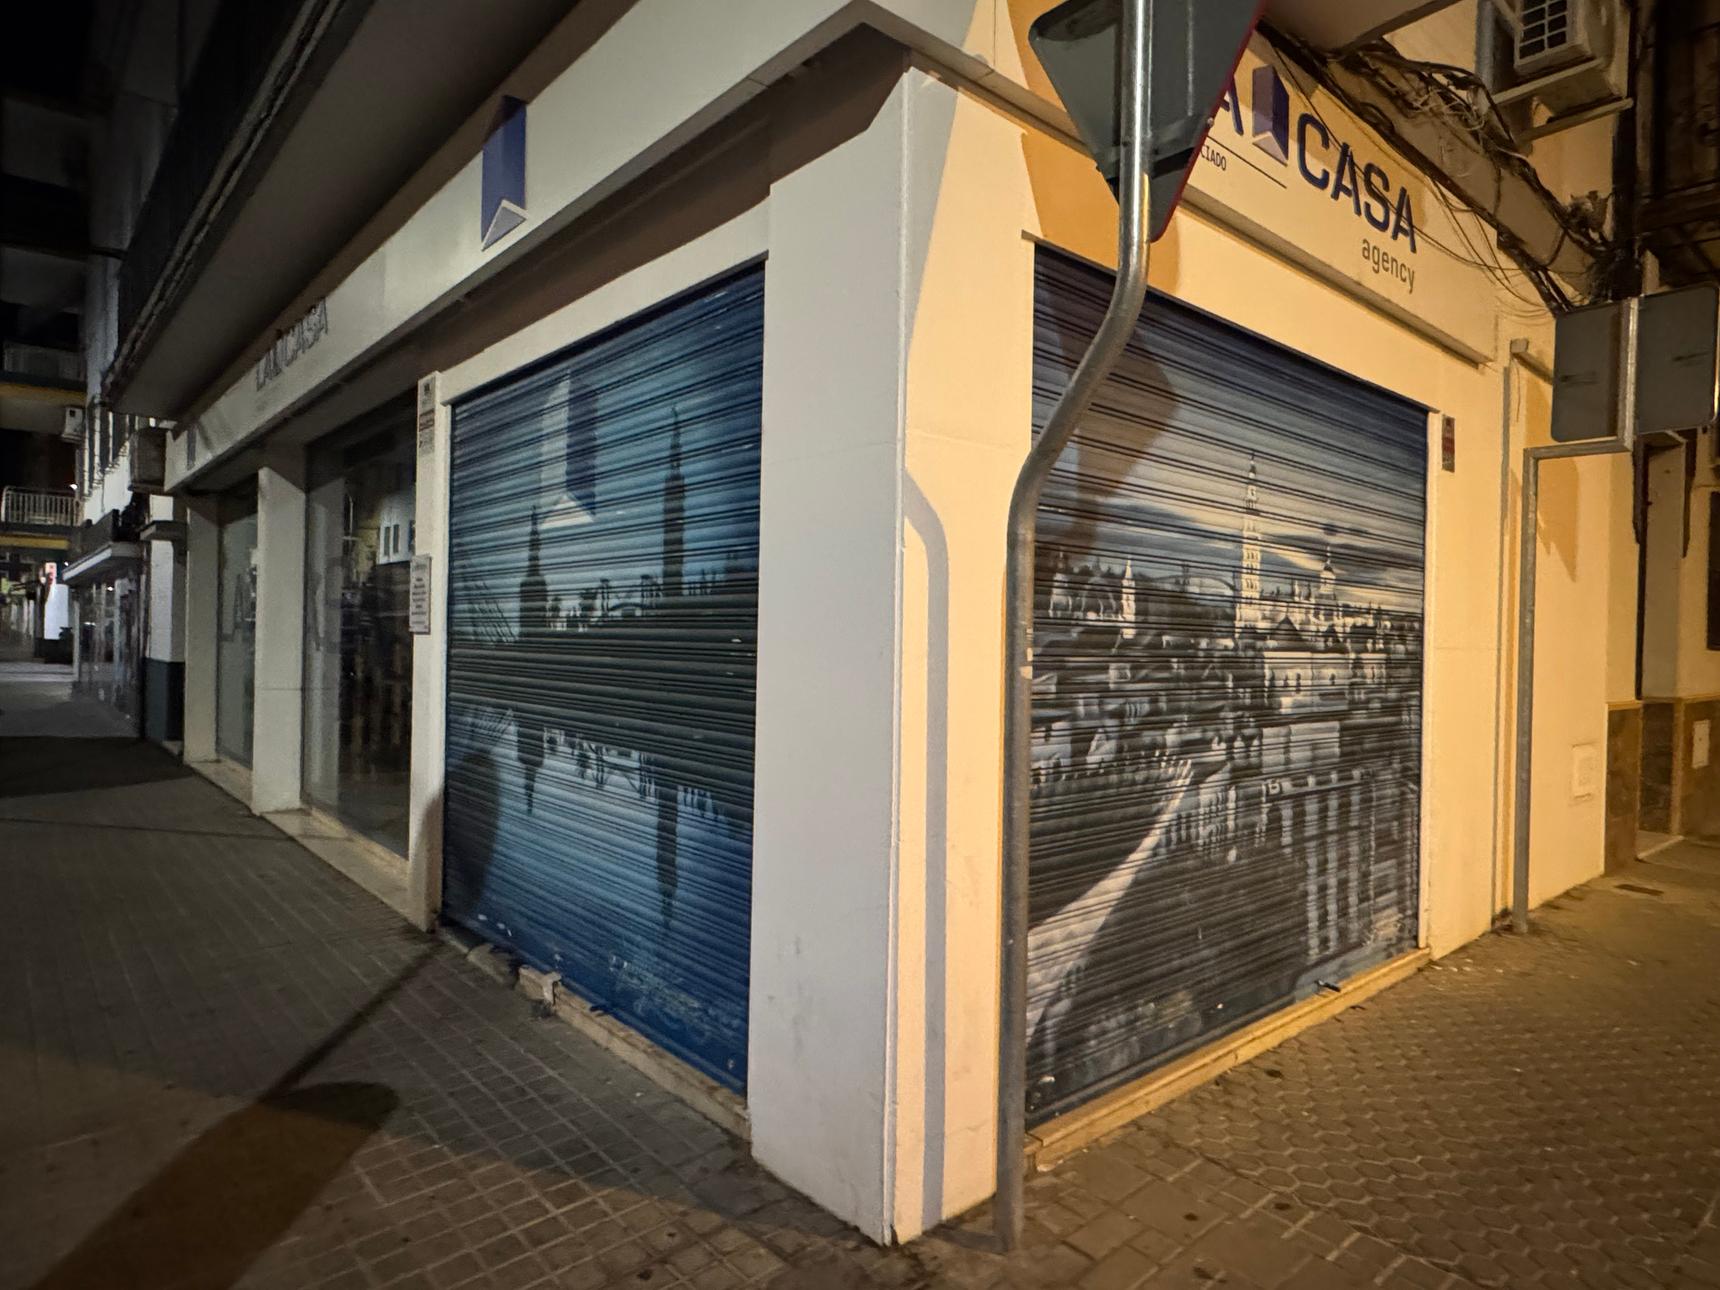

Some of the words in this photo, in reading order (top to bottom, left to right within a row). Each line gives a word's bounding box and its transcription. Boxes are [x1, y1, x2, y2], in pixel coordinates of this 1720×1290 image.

[1200, 145, 1227, 171] CIADO
[1296, 112, 1417, 253] CASA
[1361, 238, 1415, 294] agency
